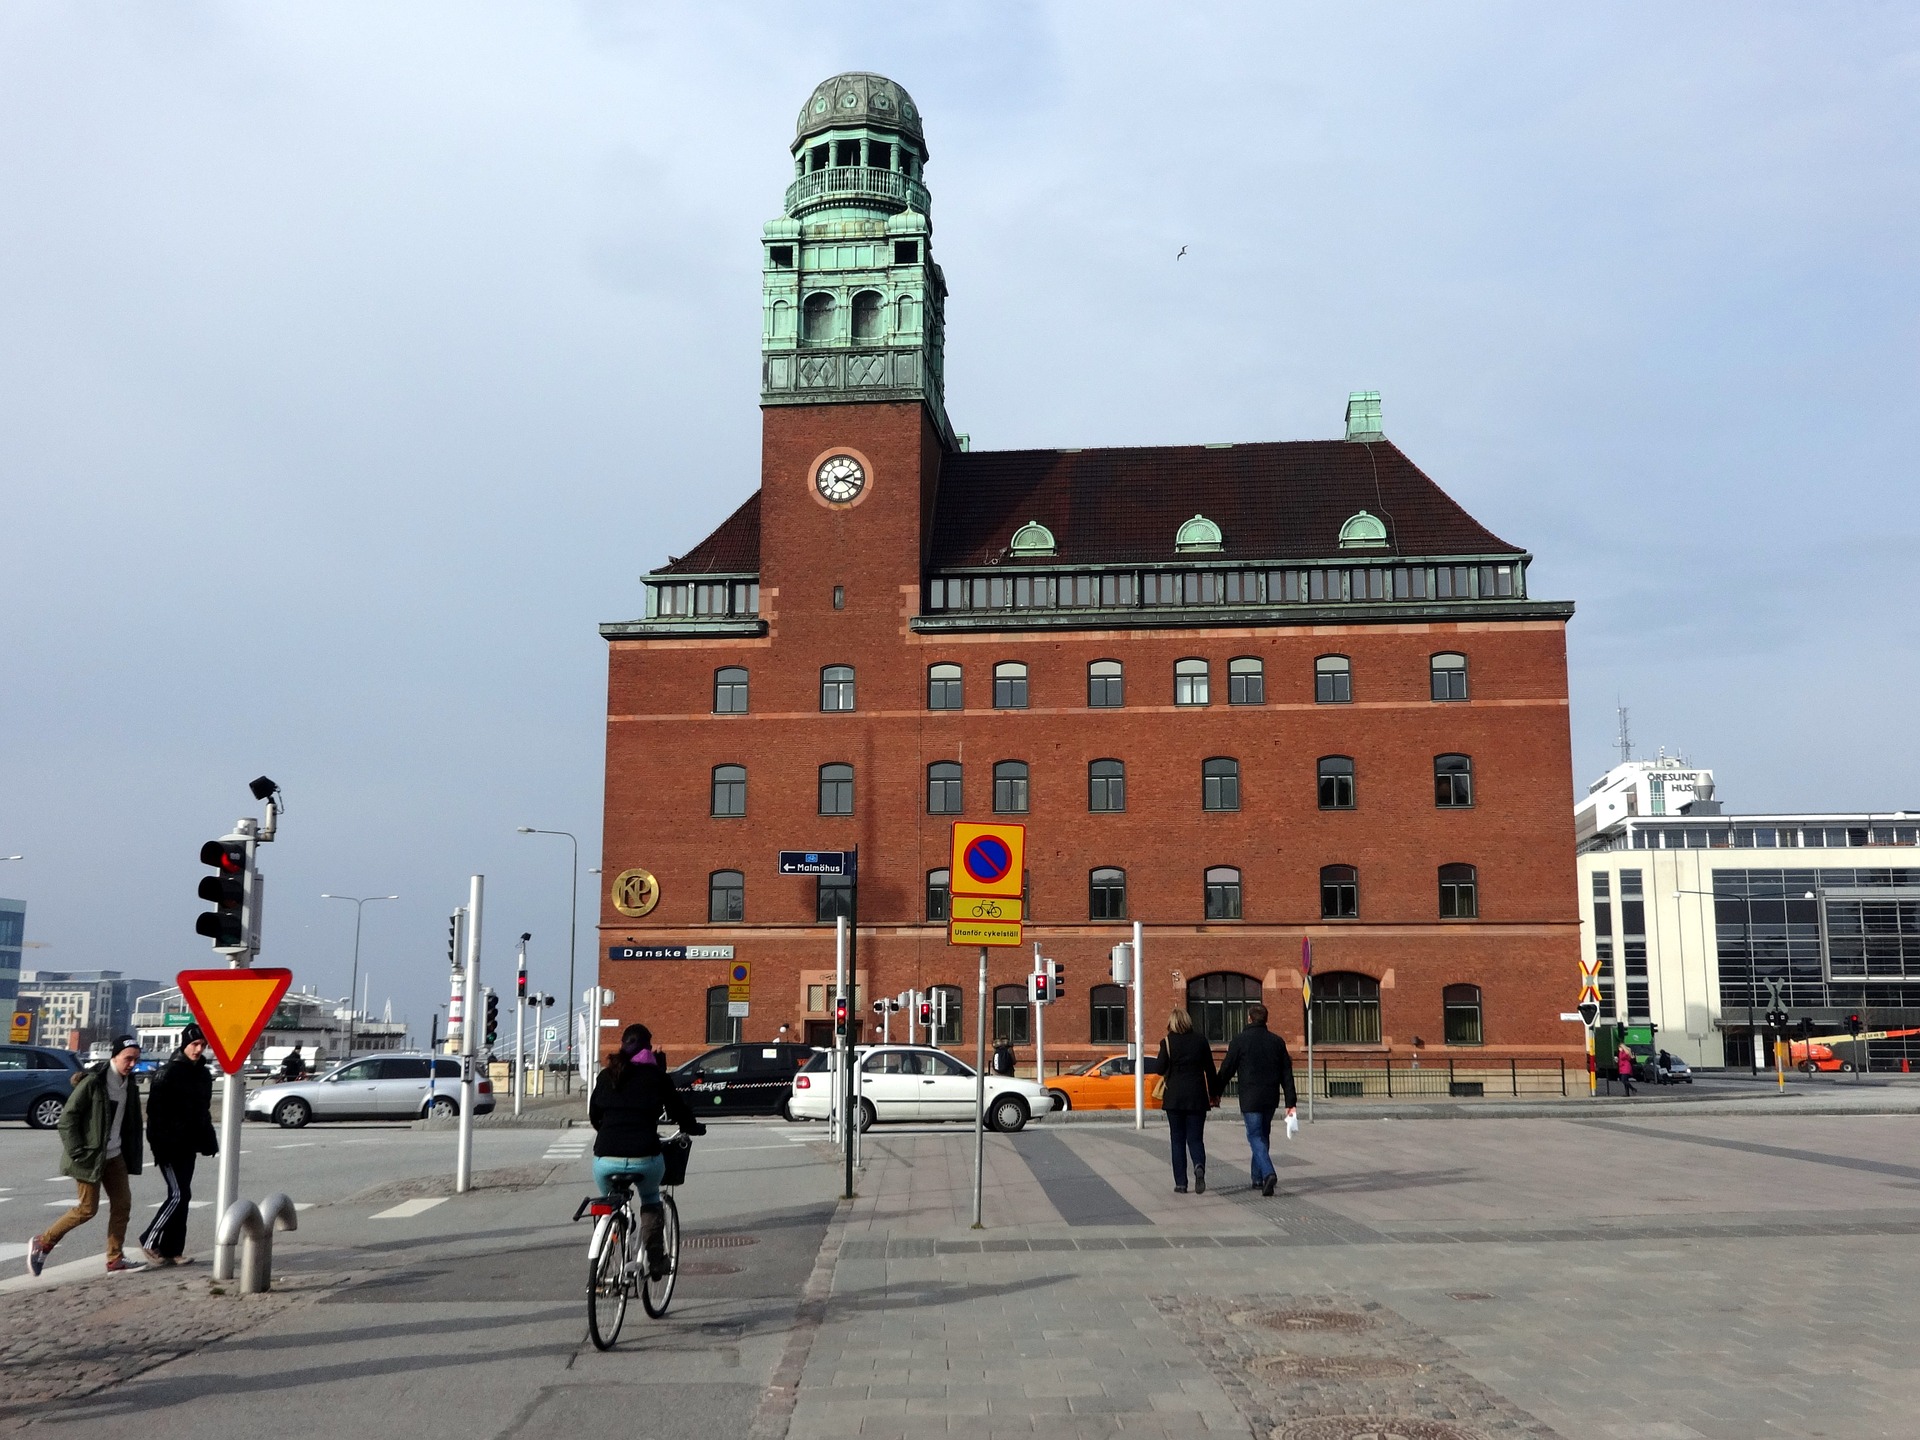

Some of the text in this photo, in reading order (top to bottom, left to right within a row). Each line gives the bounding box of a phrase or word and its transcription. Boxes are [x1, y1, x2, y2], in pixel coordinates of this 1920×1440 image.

[797, 863, 840, 872] Malmöhus
[984, 930, 1019, 938] cykelställ
[623, 948, 729, 958] Danske Bank
